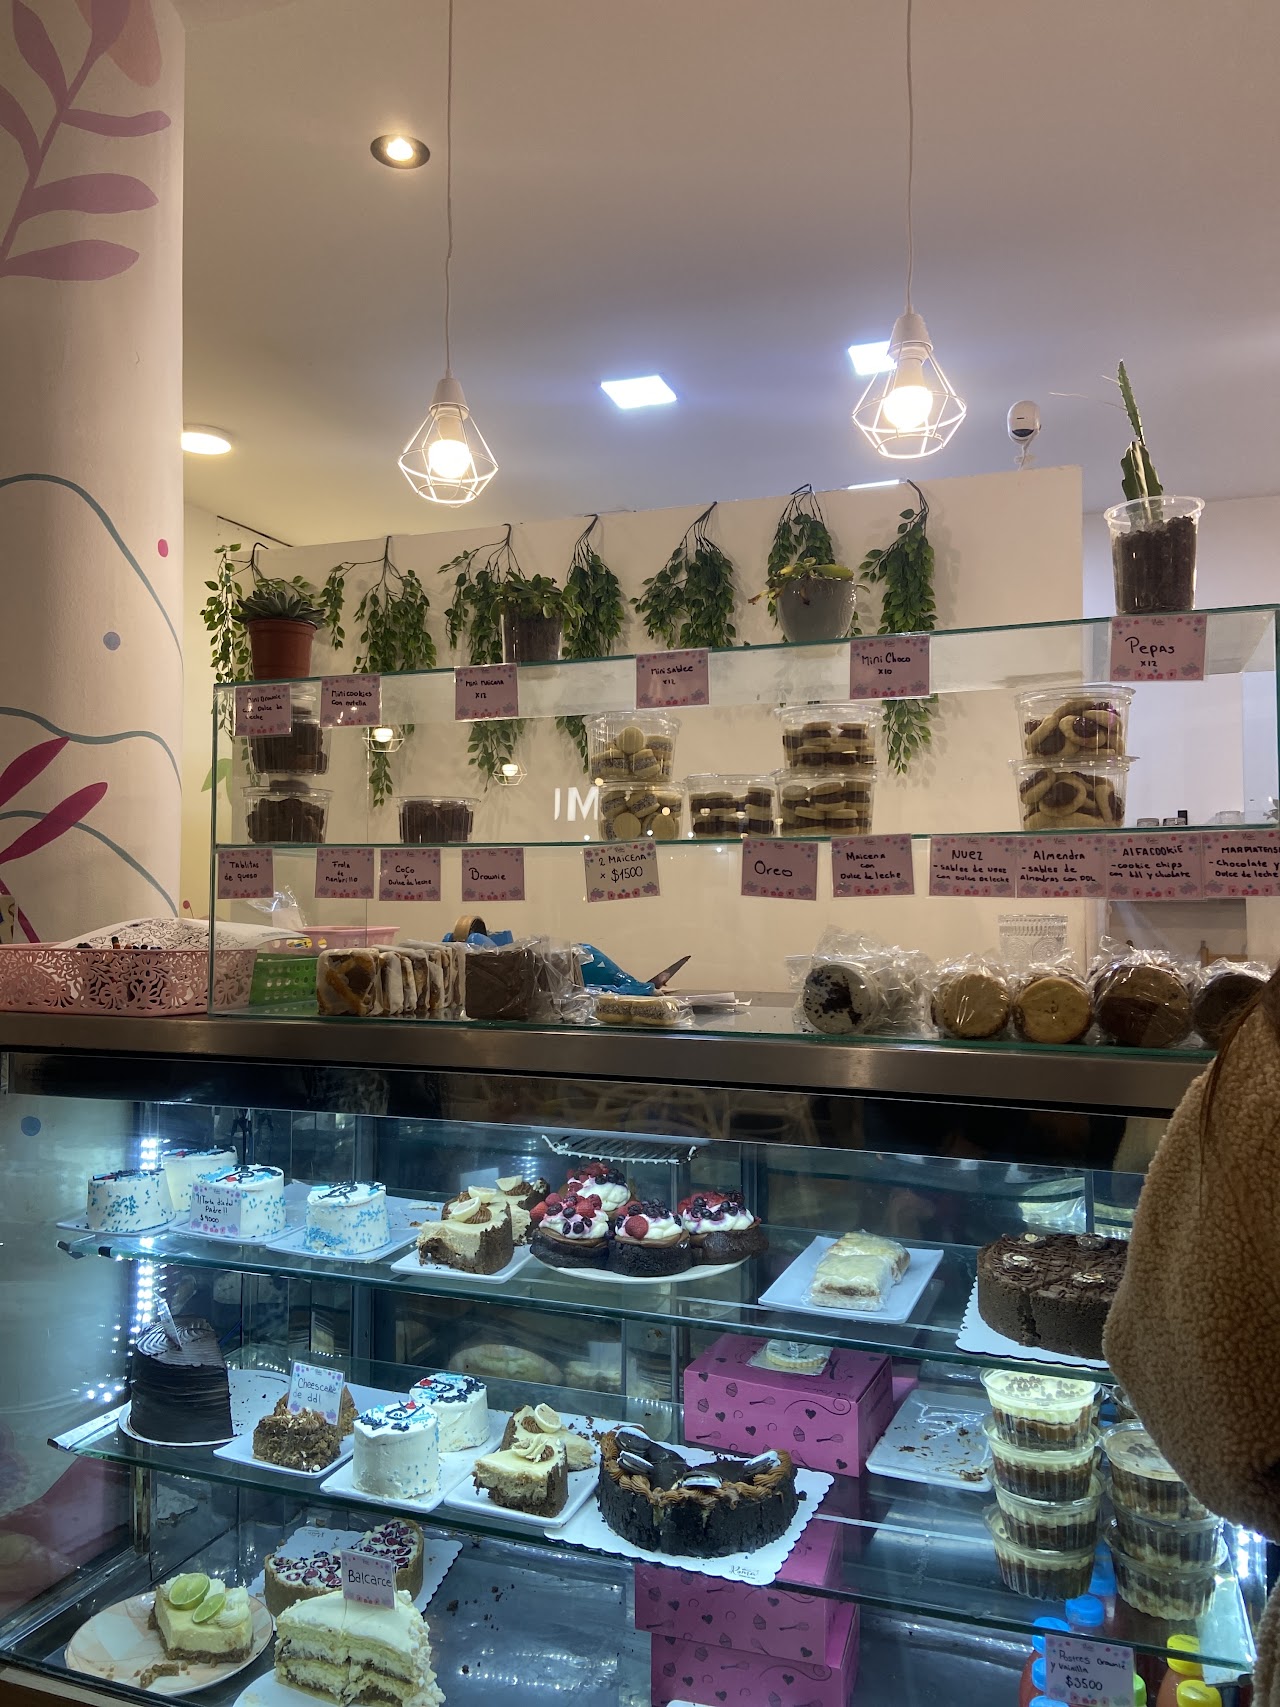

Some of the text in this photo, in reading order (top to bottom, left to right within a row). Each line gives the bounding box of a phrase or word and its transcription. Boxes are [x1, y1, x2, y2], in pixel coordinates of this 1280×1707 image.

[1124, 636, 1175, 658] Pepas
[861, 652, 911, 666] Mini Choco
[598, 857, 606, 866] 2
[846, 852, 886, 861] Maicena
[1033, 849, 1086, 861] Almendra
[754, 859, 793, 877] Oreo
[972, 864, 984, 873] de
[1064, 863, 1078, 873] de
[1155, 861, 1183, 870] chips
[224, 872, 258, 883] de queso
[468, 867, 507, 881] Brownie
[611, 865, 643, 884] $1500
[864, 871, 874, 880] de
[875, 870, 901, 879] leche
[1241, 870, 1252, 878] de
[1254, 870, 1279, 878] leche
[292, 1388, 321, 1404] de ddl
[348, 1569, 392, 1588] Balcarce
[1059, 1649, 1091, 1665] Postres
[1050, 1661, 1056, 1674] y
[1065, 1674, 1103, 1691] $3500
